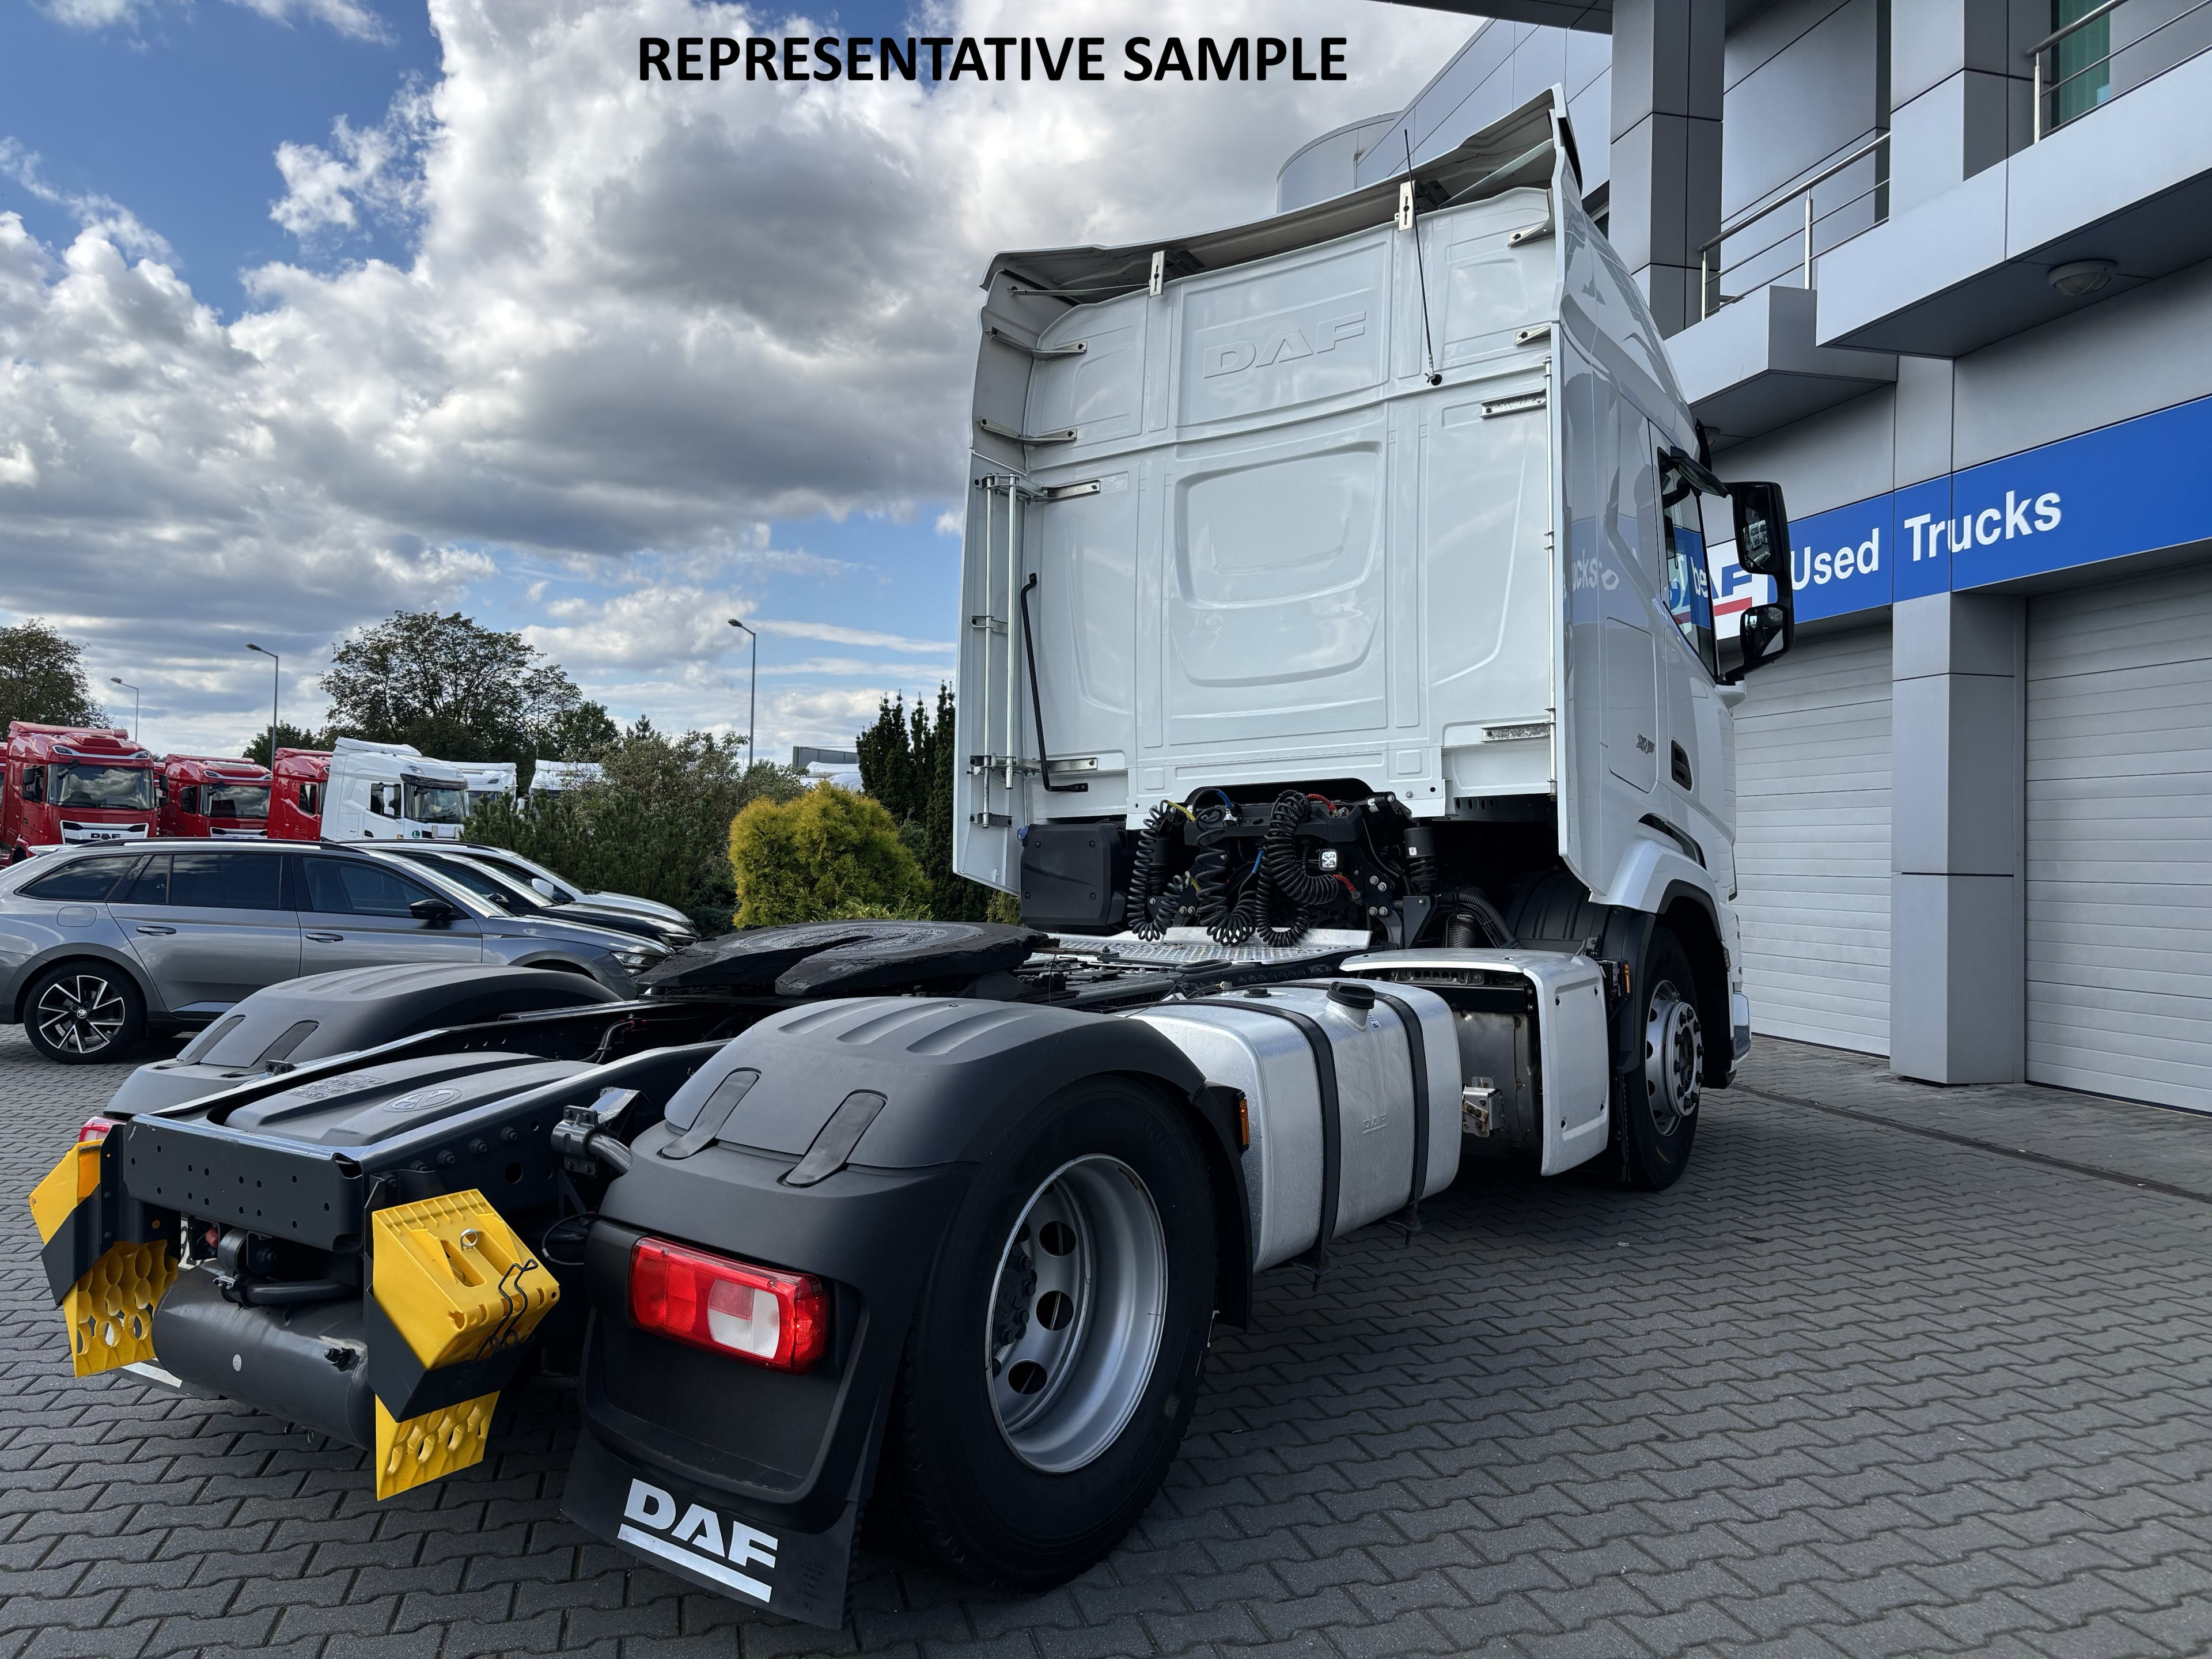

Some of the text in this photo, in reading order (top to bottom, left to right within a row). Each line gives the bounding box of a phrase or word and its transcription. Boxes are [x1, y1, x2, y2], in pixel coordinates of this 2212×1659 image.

[1203, 310, 1366, 378] DAF
[1790, 528, 1880, 590] Used
[1904, 490, 2061, 562] Trucks
[1363, 1113, 1387, 1130] DAF
[624, 1478, 778, 1569] DAF
